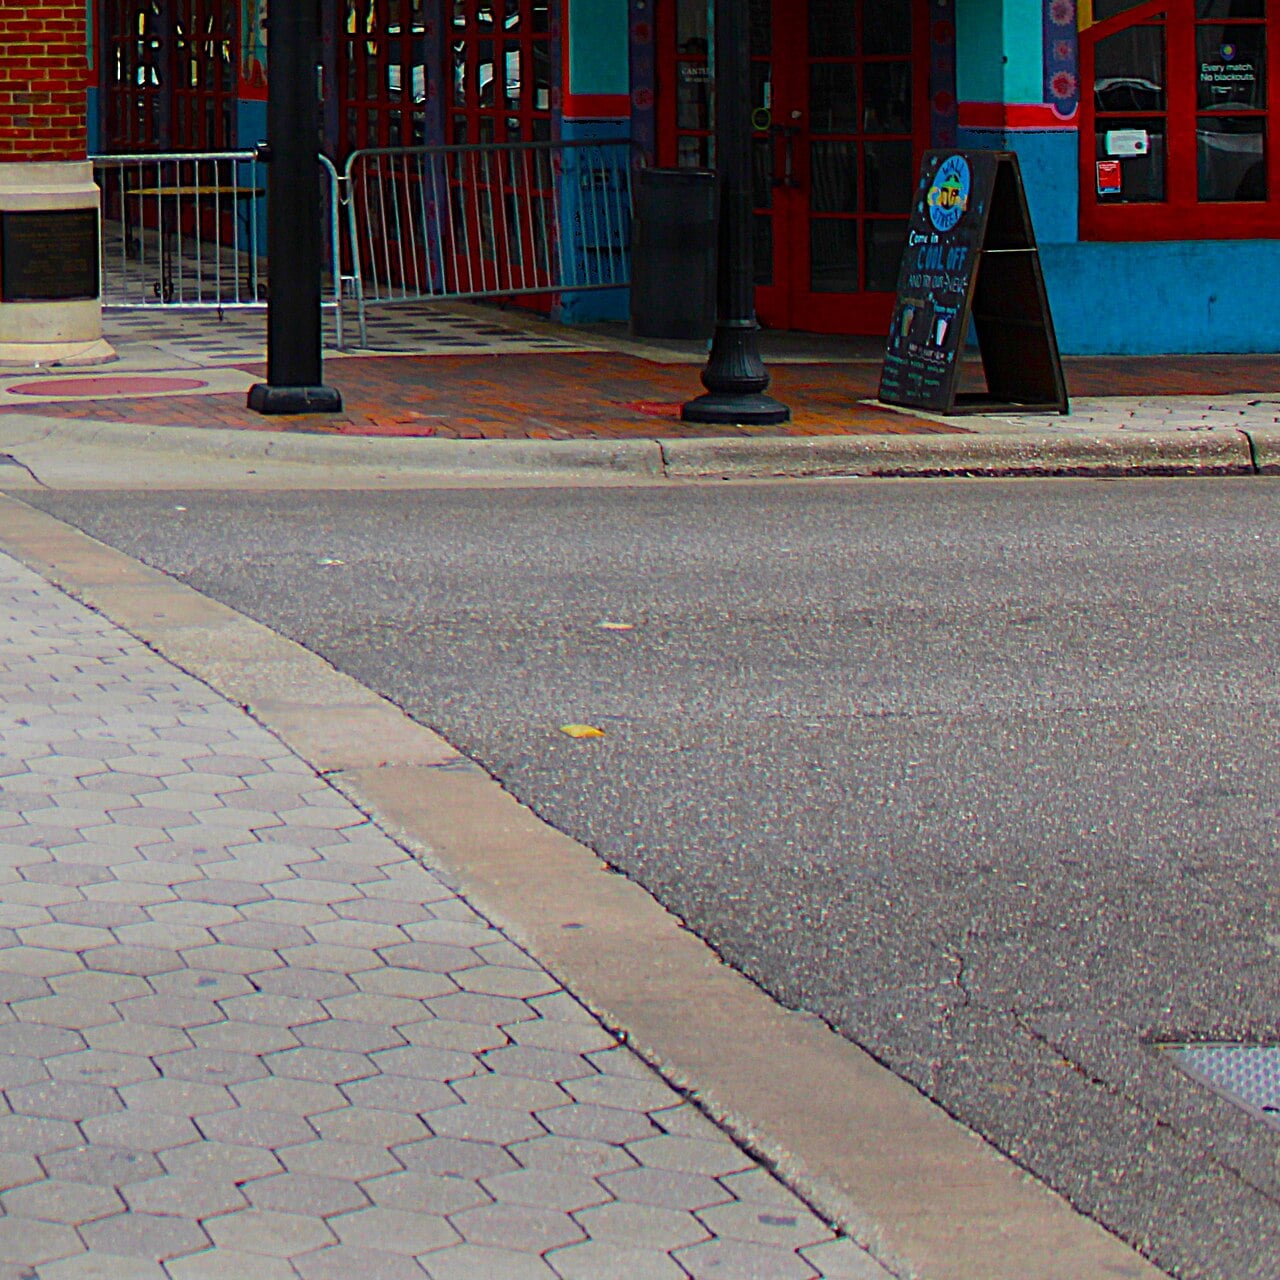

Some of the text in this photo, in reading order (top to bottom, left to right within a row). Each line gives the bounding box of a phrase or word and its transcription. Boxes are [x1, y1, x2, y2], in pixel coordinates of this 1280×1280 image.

[1201, 63, 1225, 72] Every
[1200, 73, 1256, 81] No blackouts.
[917, 244, 969, 271] COOL OFF
